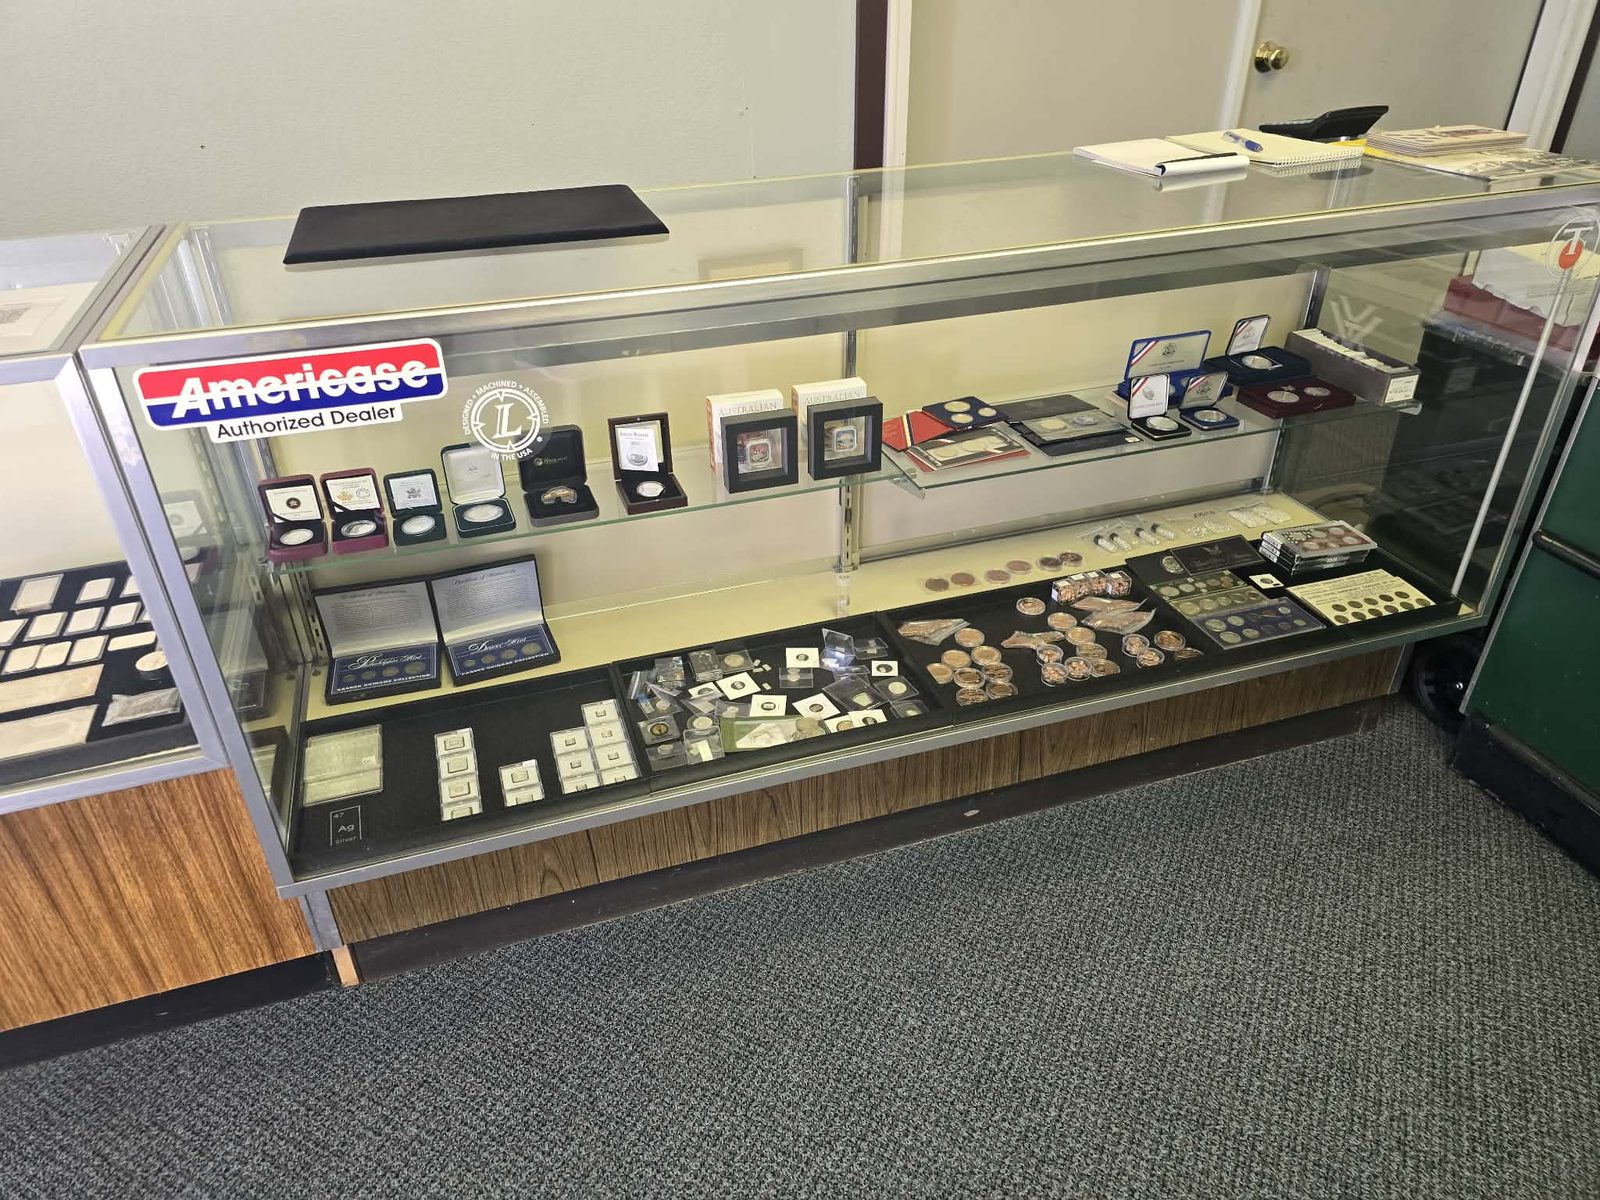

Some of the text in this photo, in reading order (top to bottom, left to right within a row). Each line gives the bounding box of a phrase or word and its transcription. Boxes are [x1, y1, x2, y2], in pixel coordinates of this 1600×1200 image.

[172, 358, 431, 419] Americase
[217, 405, 396, 439] Authorized Dealer
[462, 380, 549, 436] DESIGNED MACHINED ASSEMBLED
[492, 402, 522, 439] L
[718, 399, 777, 416] AUSTRALIAN
[491, 452, 500, 460] IN
[517, 448, 533, 458] USA
[338, 824, 354, 833] Ag
